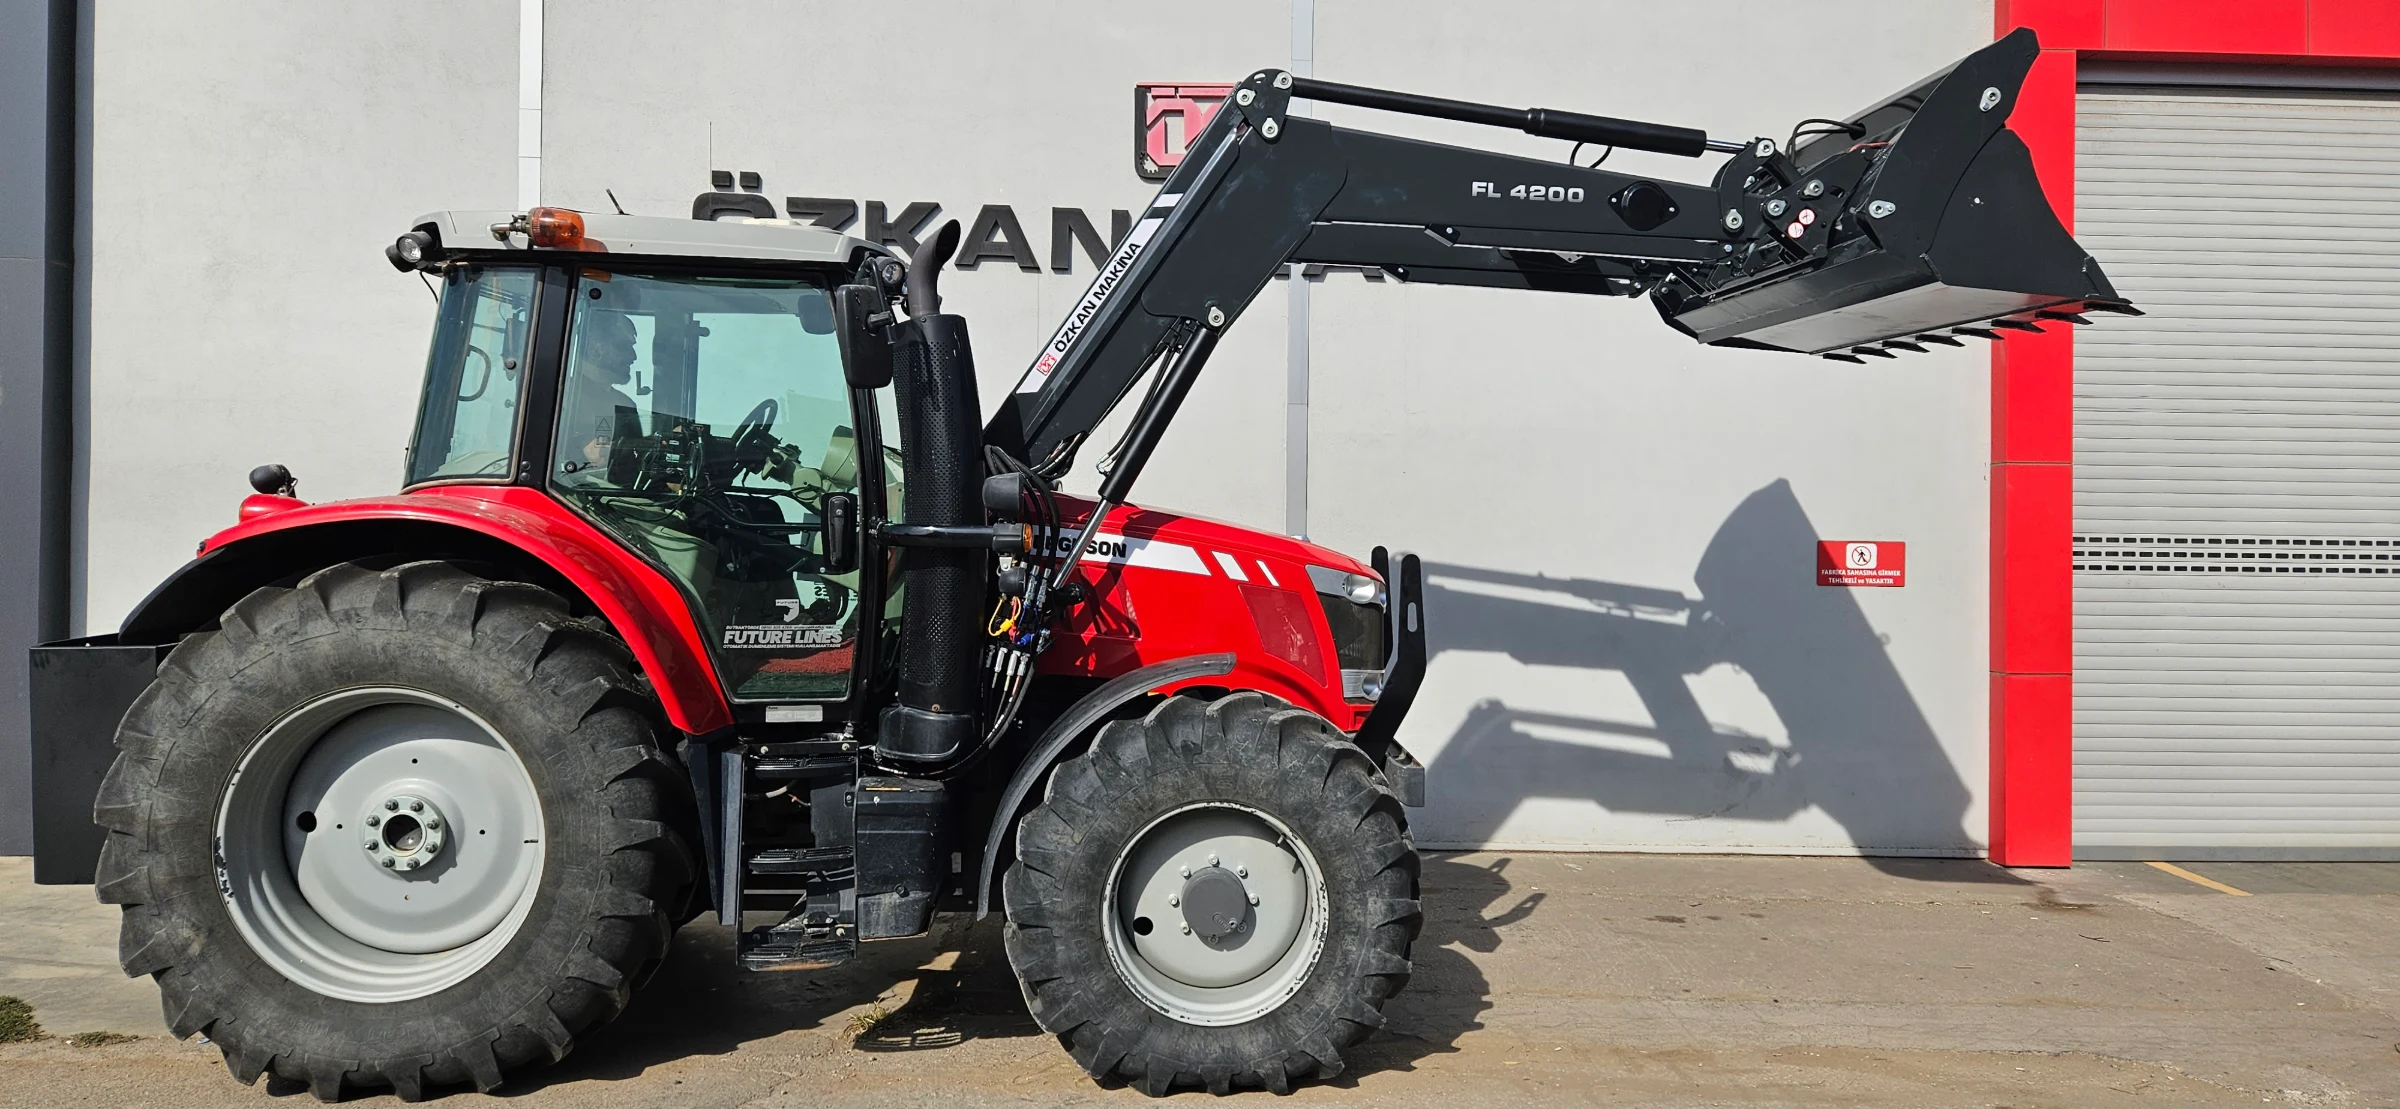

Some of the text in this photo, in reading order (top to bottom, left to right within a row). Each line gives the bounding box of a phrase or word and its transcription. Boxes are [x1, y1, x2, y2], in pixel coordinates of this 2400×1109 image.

[1471, 181, 1585, 203] FL 4200
[1053, 242, 1142, 352] ÖZKAN MAKİNA
[1878, 569, 1901, 577] GİRMEK
[723, 630, 843, 644] FUTURE LINES
